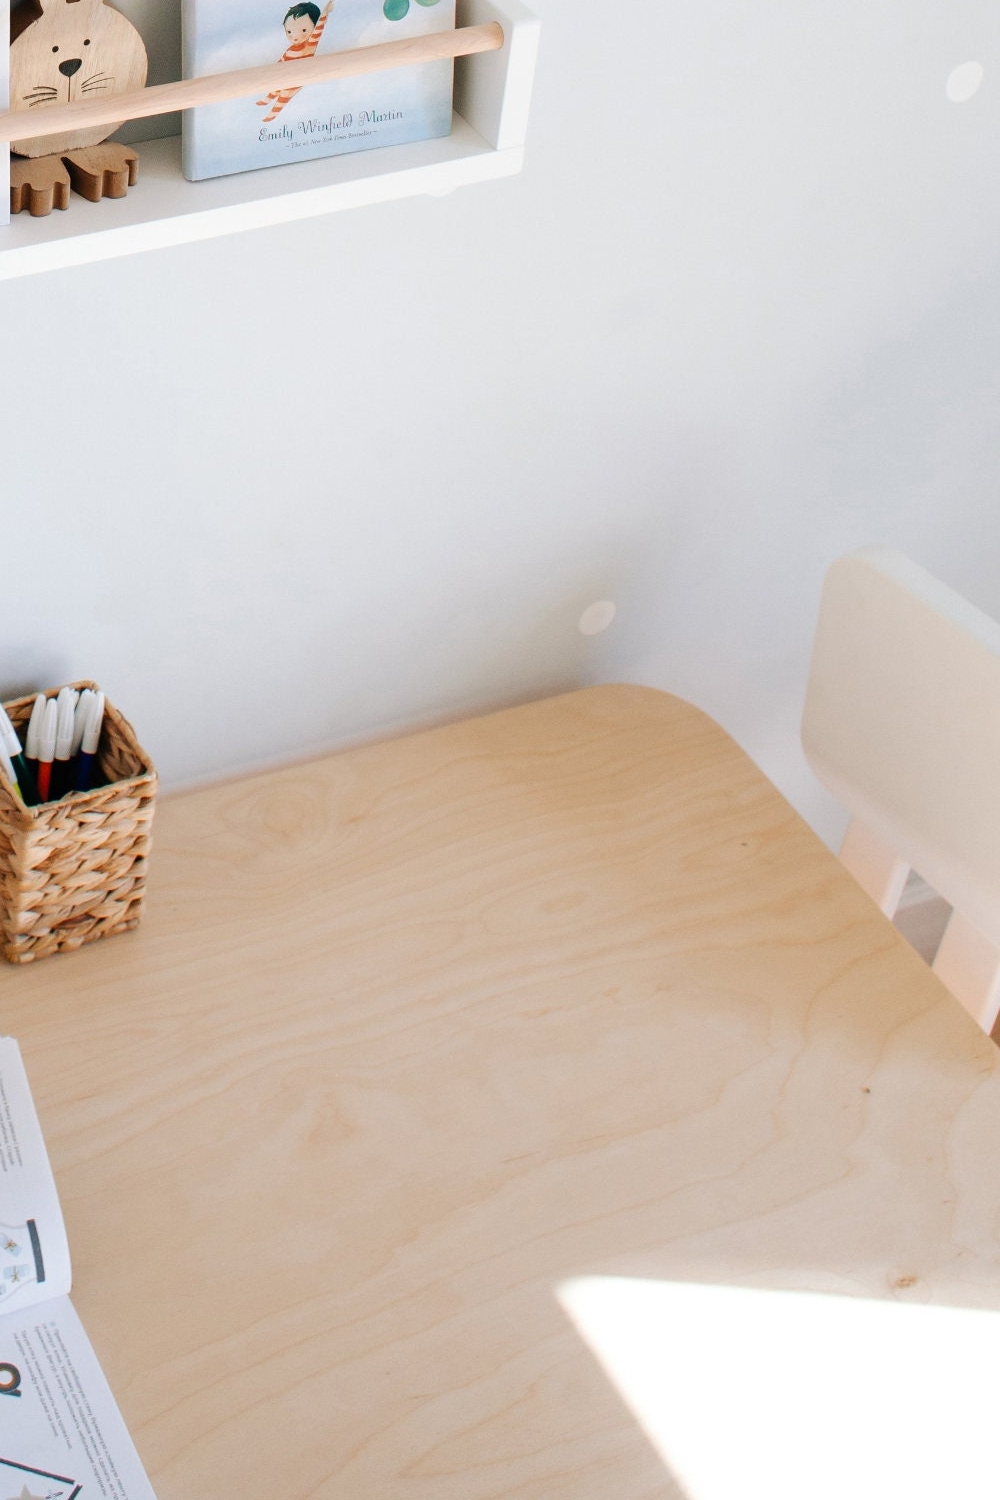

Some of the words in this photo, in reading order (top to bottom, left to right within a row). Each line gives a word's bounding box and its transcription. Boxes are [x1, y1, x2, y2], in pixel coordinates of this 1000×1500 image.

[258, 124, 293, 142] Emily
[298, 113, 353, 134] Winfield
[358, 109, 404, 126] Martin
